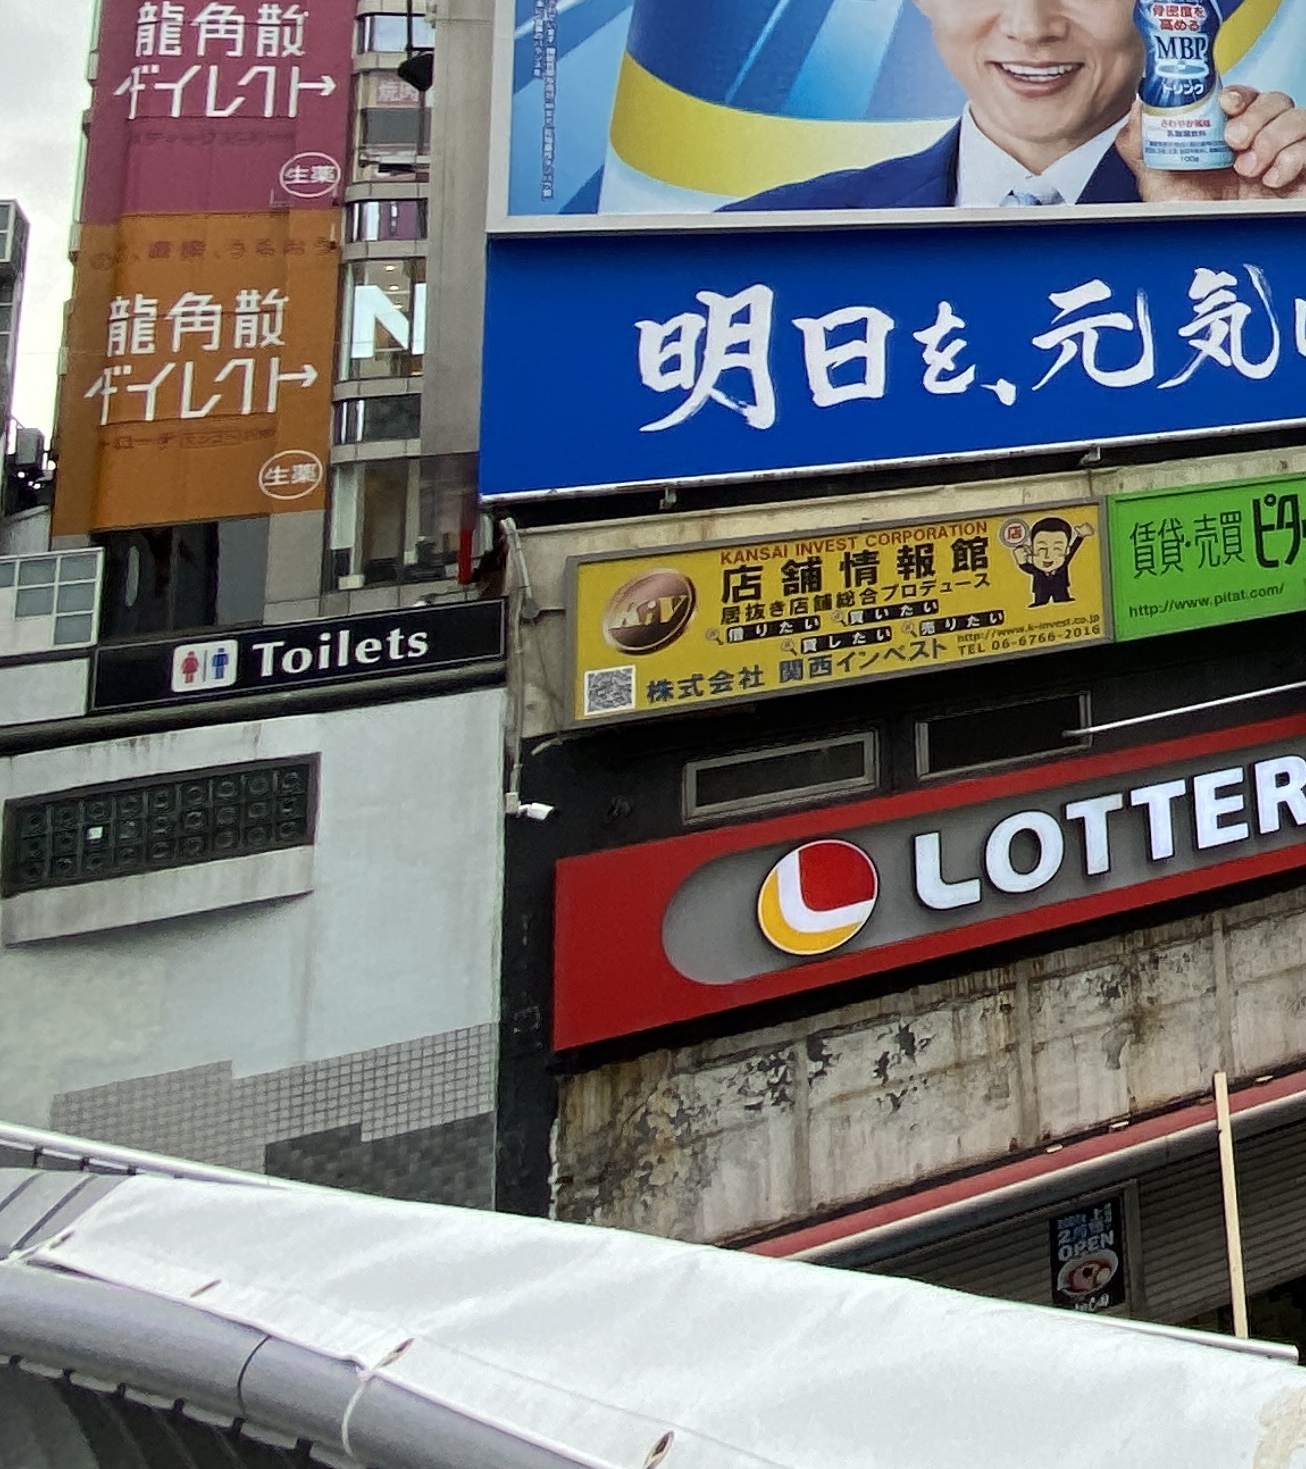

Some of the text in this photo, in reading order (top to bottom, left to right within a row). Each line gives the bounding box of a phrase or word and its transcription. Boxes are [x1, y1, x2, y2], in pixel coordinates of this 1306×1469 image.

[135, 0, 310, 58] 龍角散
[1155, 34, 1206, 60] MBP
[106, 287, 290, 358] 龍角散
[720, 520, 989, 566] KANSAI INVEST CORPORATION
[1129, 510, 1246, 579] 賃貸・売買
[720, 535, 990, 604] 店舗情報館
[720, 572, 991, 625] 居抜き店舗総合プロデュース
[848, 599, 939, 626] 買いたい
[1128, 582, 1285, 619] http://www.pitat.com/
[727, 616, 821, 643] 借りたい
[919, 610, 1004, 636] 売りたい
[957, 624, 1101, 657] TEL 06-6766-2016
[251, 625, 431, 680] Toilets
[645, 637, 948, 705] 株式会社 関西インベスト
[1057, 1229, 1115, 1262] OPEN
